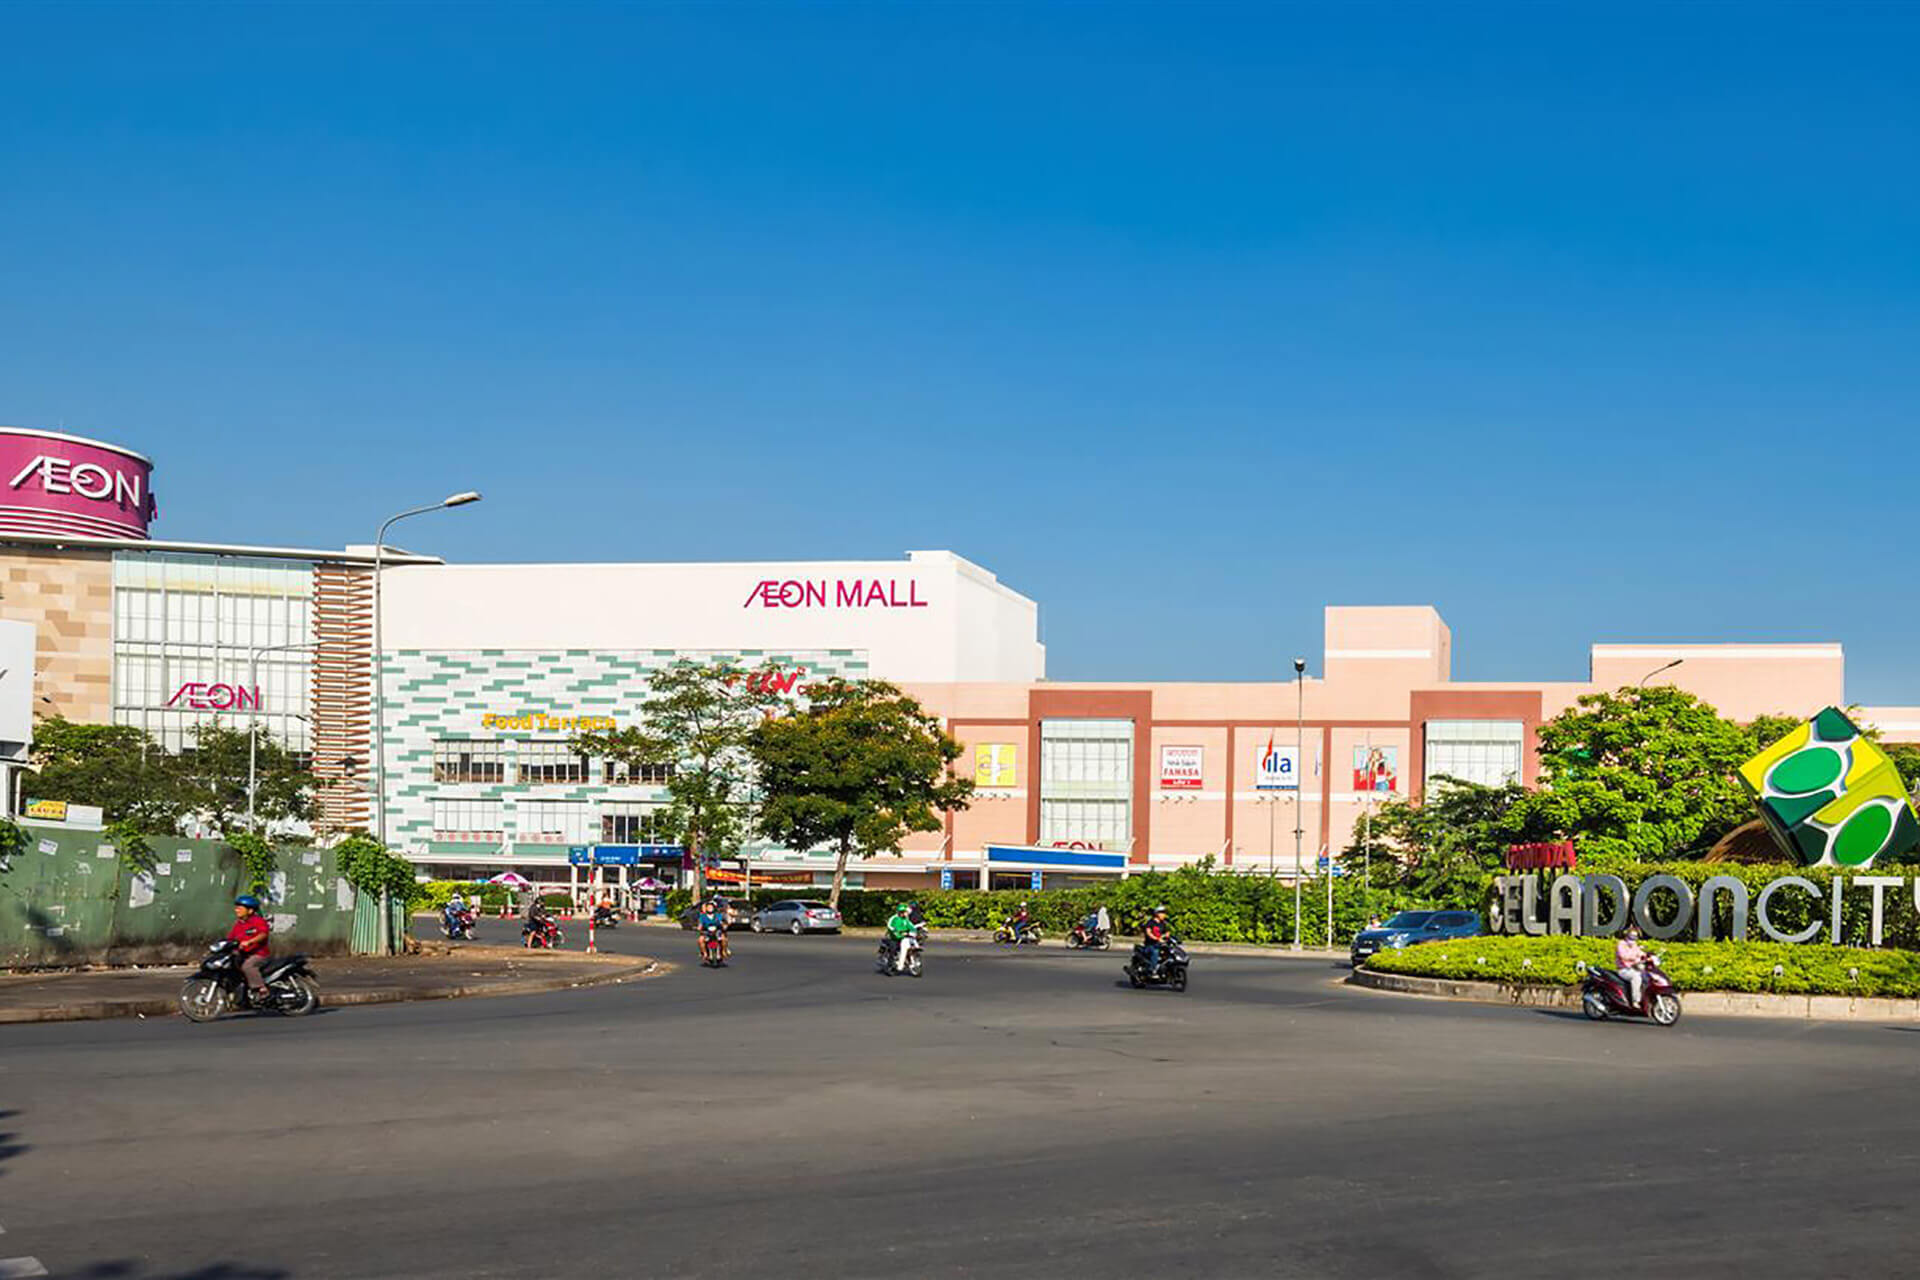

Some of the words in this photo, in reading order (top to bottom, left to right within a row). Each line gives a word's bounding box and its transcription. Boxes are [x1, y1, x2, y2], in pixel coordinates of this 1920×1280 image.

[835, 579, 928, 607] MALL
[482, 713, 533, 730] Food
[1756, 875, 1920, 945] CIT
